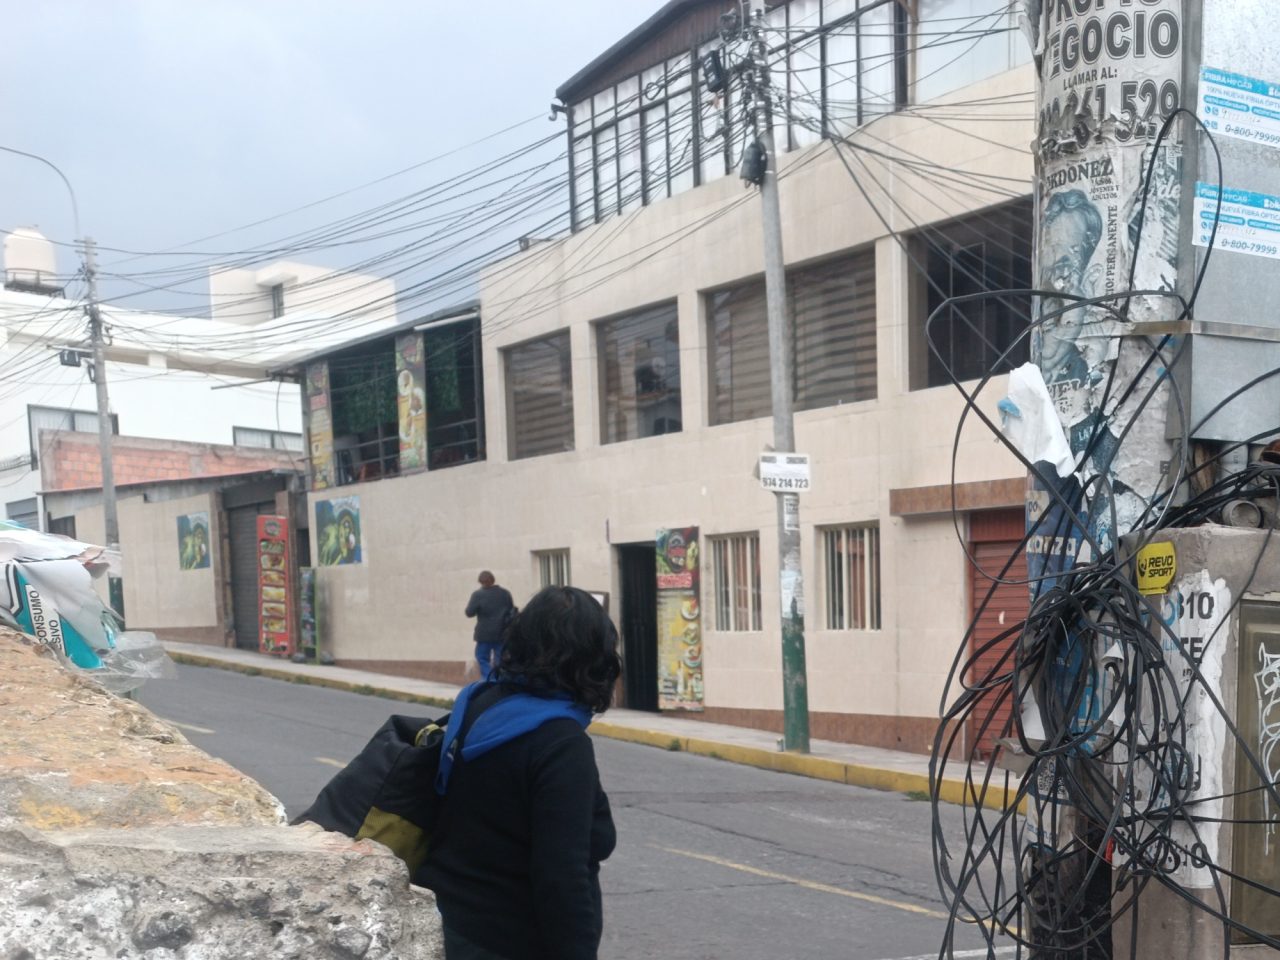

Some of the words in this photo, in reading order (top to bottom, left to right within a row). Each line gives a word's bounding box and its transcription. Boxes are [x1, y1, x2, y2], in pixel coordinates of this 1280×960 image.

[1063, 71, 1098, 91] LLAMAR
[1100, 68, 1118, 79] AL:
[1148, 555, 1174, 567] REVO
[1148, 566, 1174, 577] SPORT
[29, 590, 48, 645] CONSUMO
